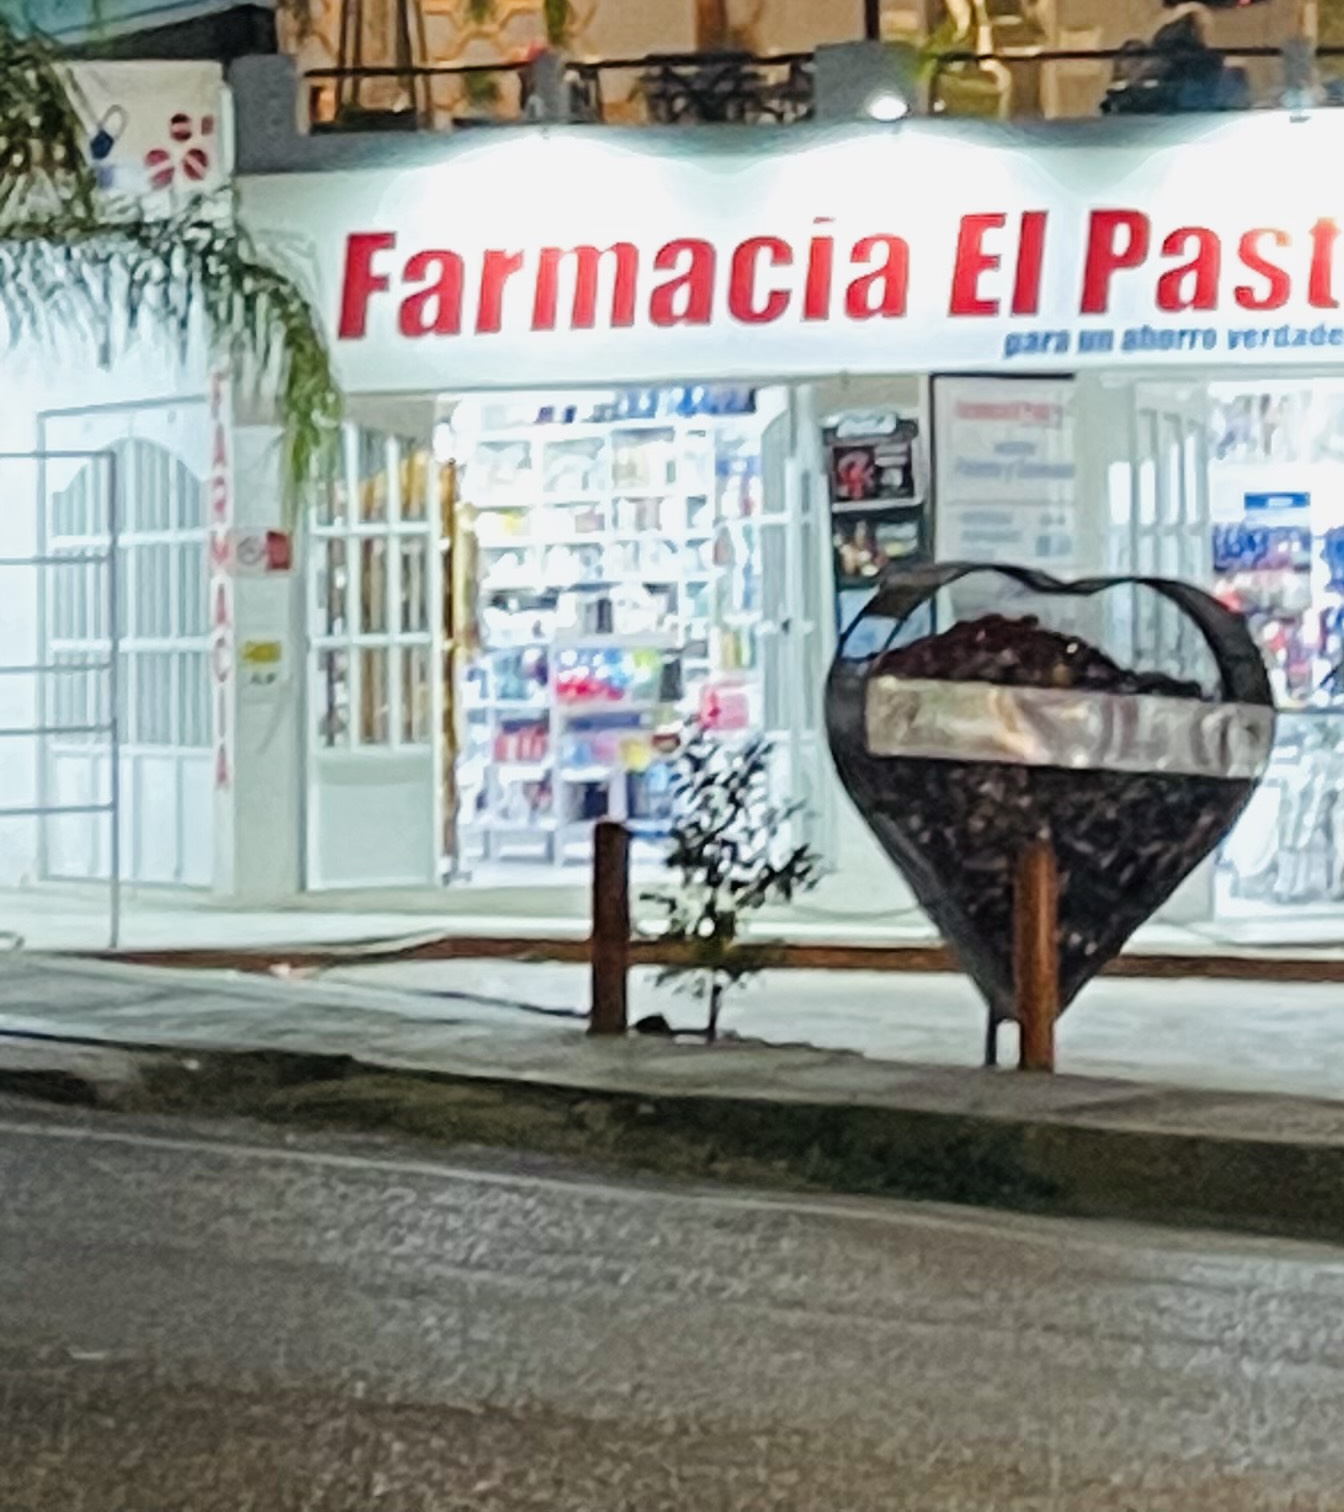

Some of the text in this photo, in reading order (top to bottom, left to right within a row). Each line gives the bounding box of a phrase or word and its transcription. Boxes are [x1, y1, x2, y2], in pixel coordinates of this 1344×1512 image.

[337, 217, 910, 340] Farmacia
[948, 210, 1050, 317] El
[1003, 329, 1069, 358] para
[1077, 329, 1114, 354] un
[1121, 324, 1217, 352] ahorro
